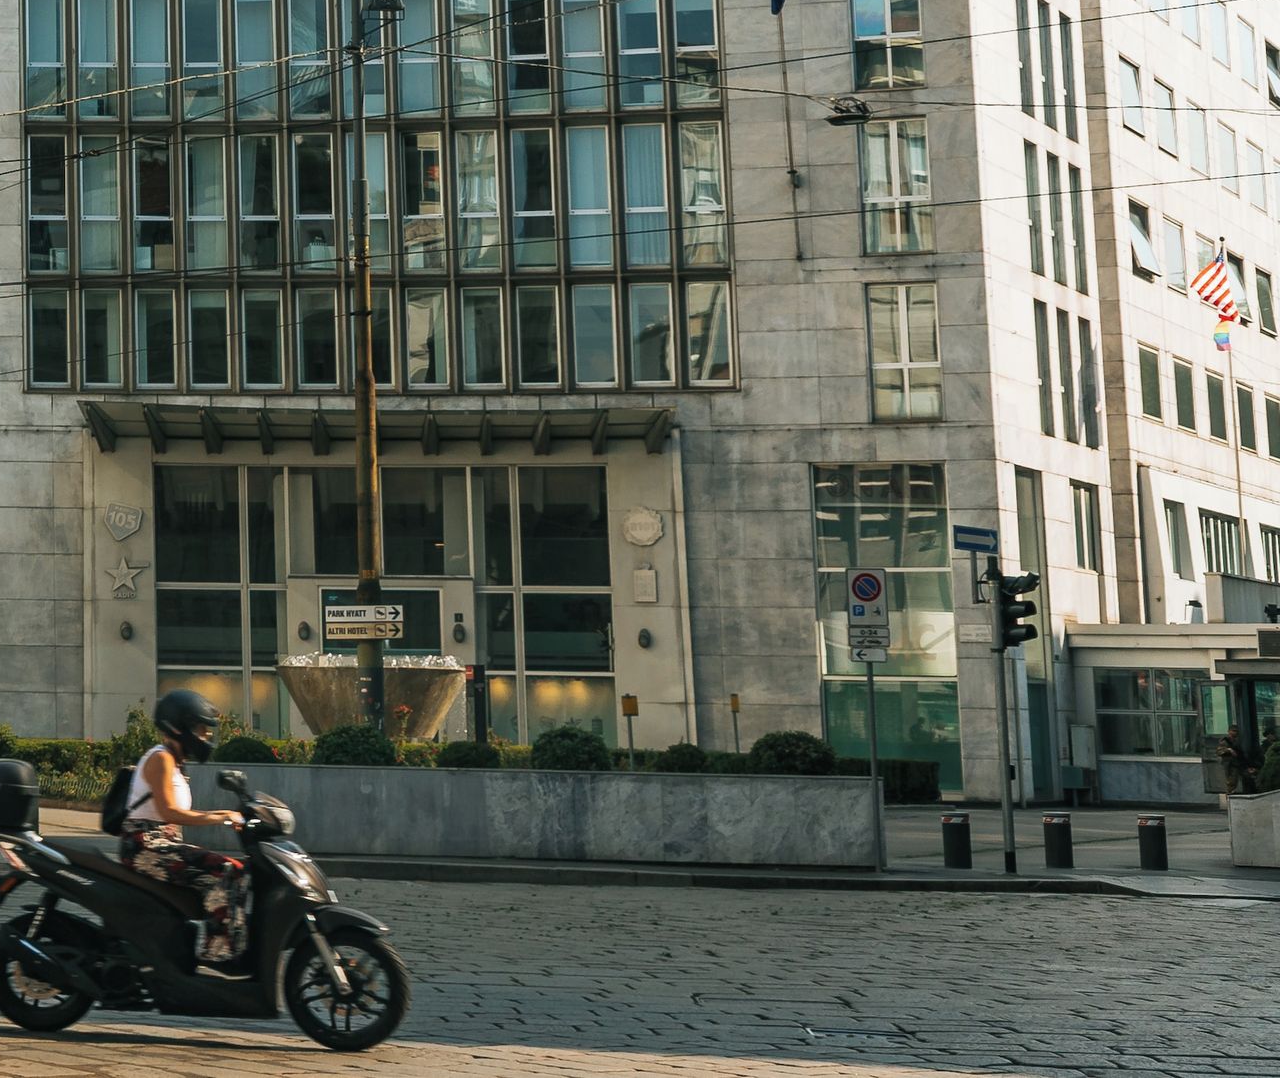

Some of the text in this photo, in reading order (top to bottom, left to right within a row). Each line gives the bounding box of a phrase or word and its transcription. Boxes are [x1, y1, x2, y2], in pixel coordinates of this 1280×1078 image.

[107, 511, 137, 530] 105
[327, 609, 367, 618] PARK HYATT
[328, 627, 368, 635] ALTRI HOTEL
